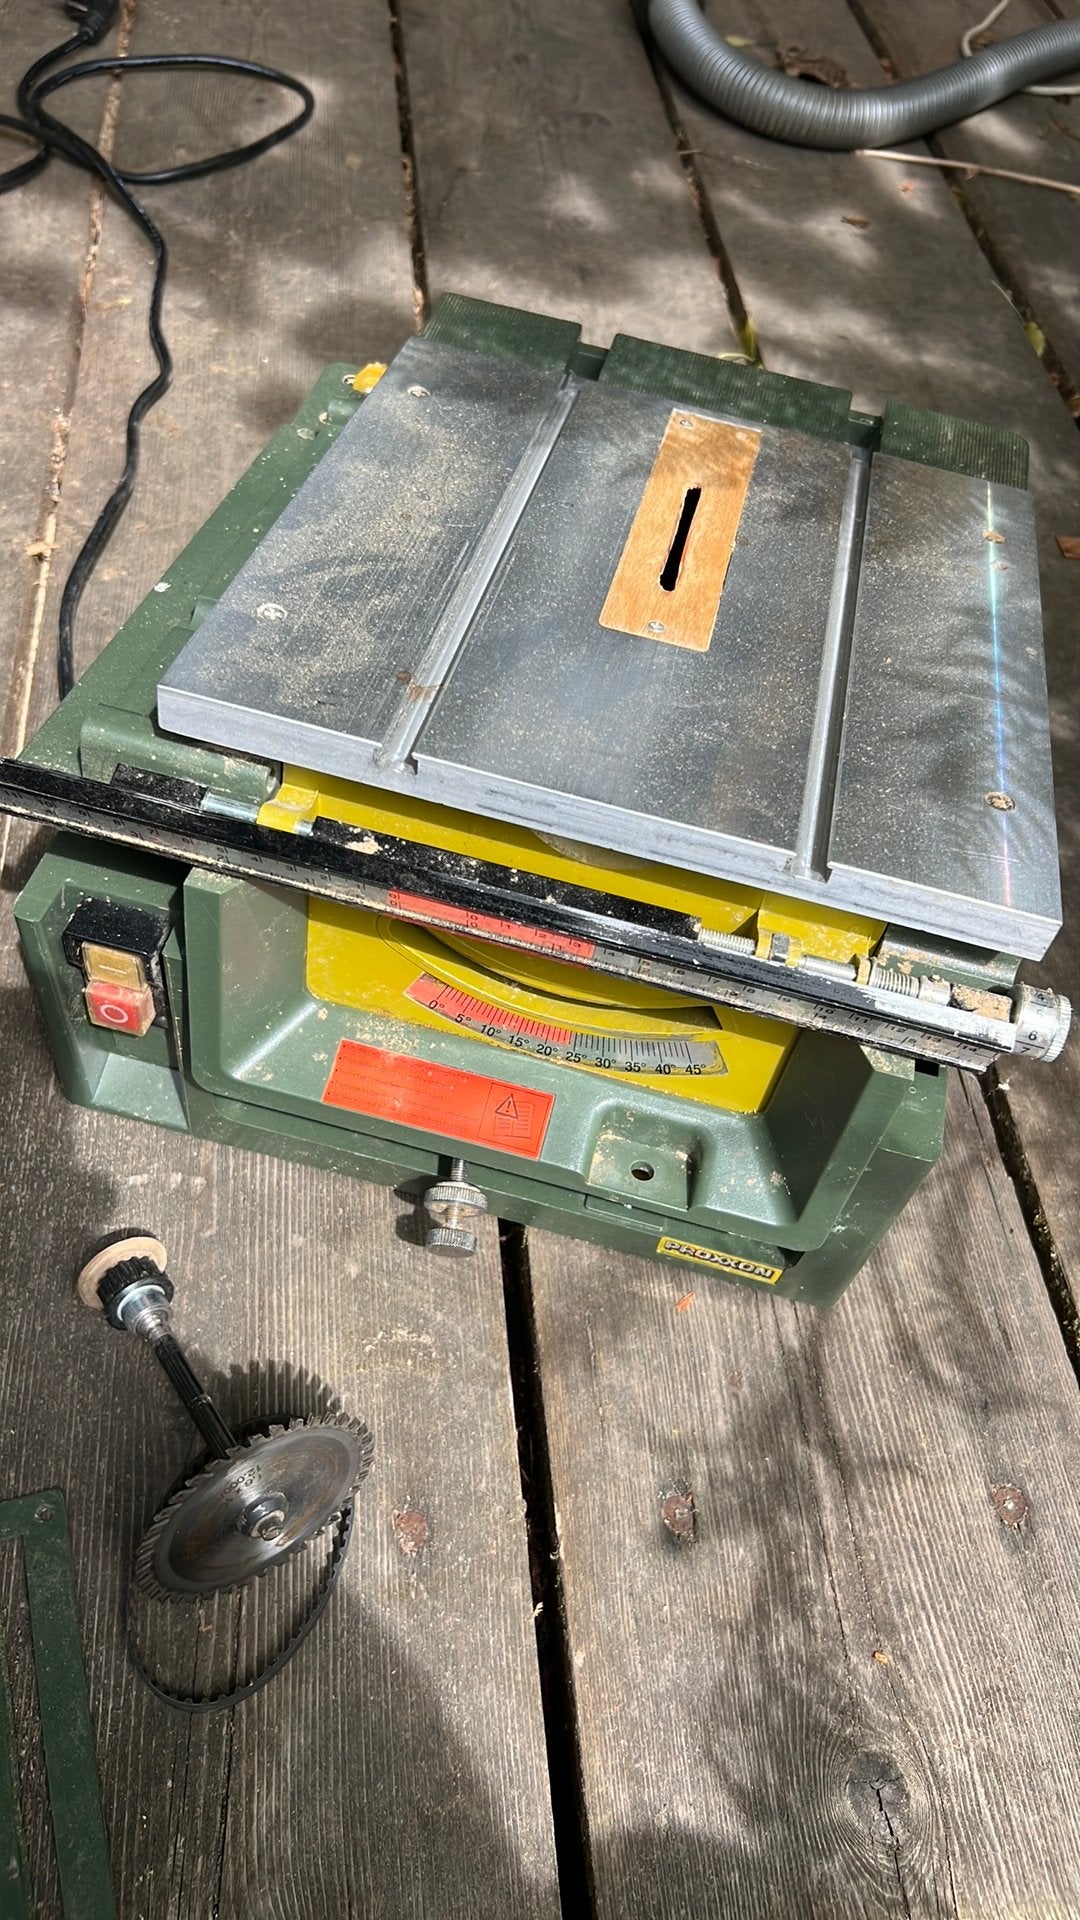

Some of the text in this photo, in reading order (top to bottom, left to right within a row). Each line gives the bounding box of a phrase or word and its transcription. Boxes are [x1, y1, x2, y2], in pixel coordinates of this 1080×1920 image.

[454, 1013, 472, 1023] 5°
[480, 1024, 502, 1037] 10°
[508, 1035, 530, 1048] 15°
[536, 1043, 558, 1057] 20°
[565, 1051, 588, 1063] 25°
[595, 1057, 616, 1069] 30°
[625, 1061, 646, 1073] 35°
[655, 1064, 676, 1075] 40°
[685, 1063, 707, 1075] 45°
[1028, 1029, 1039, 1041] 6
[663, 1240, 774, 1279] PROXXON
